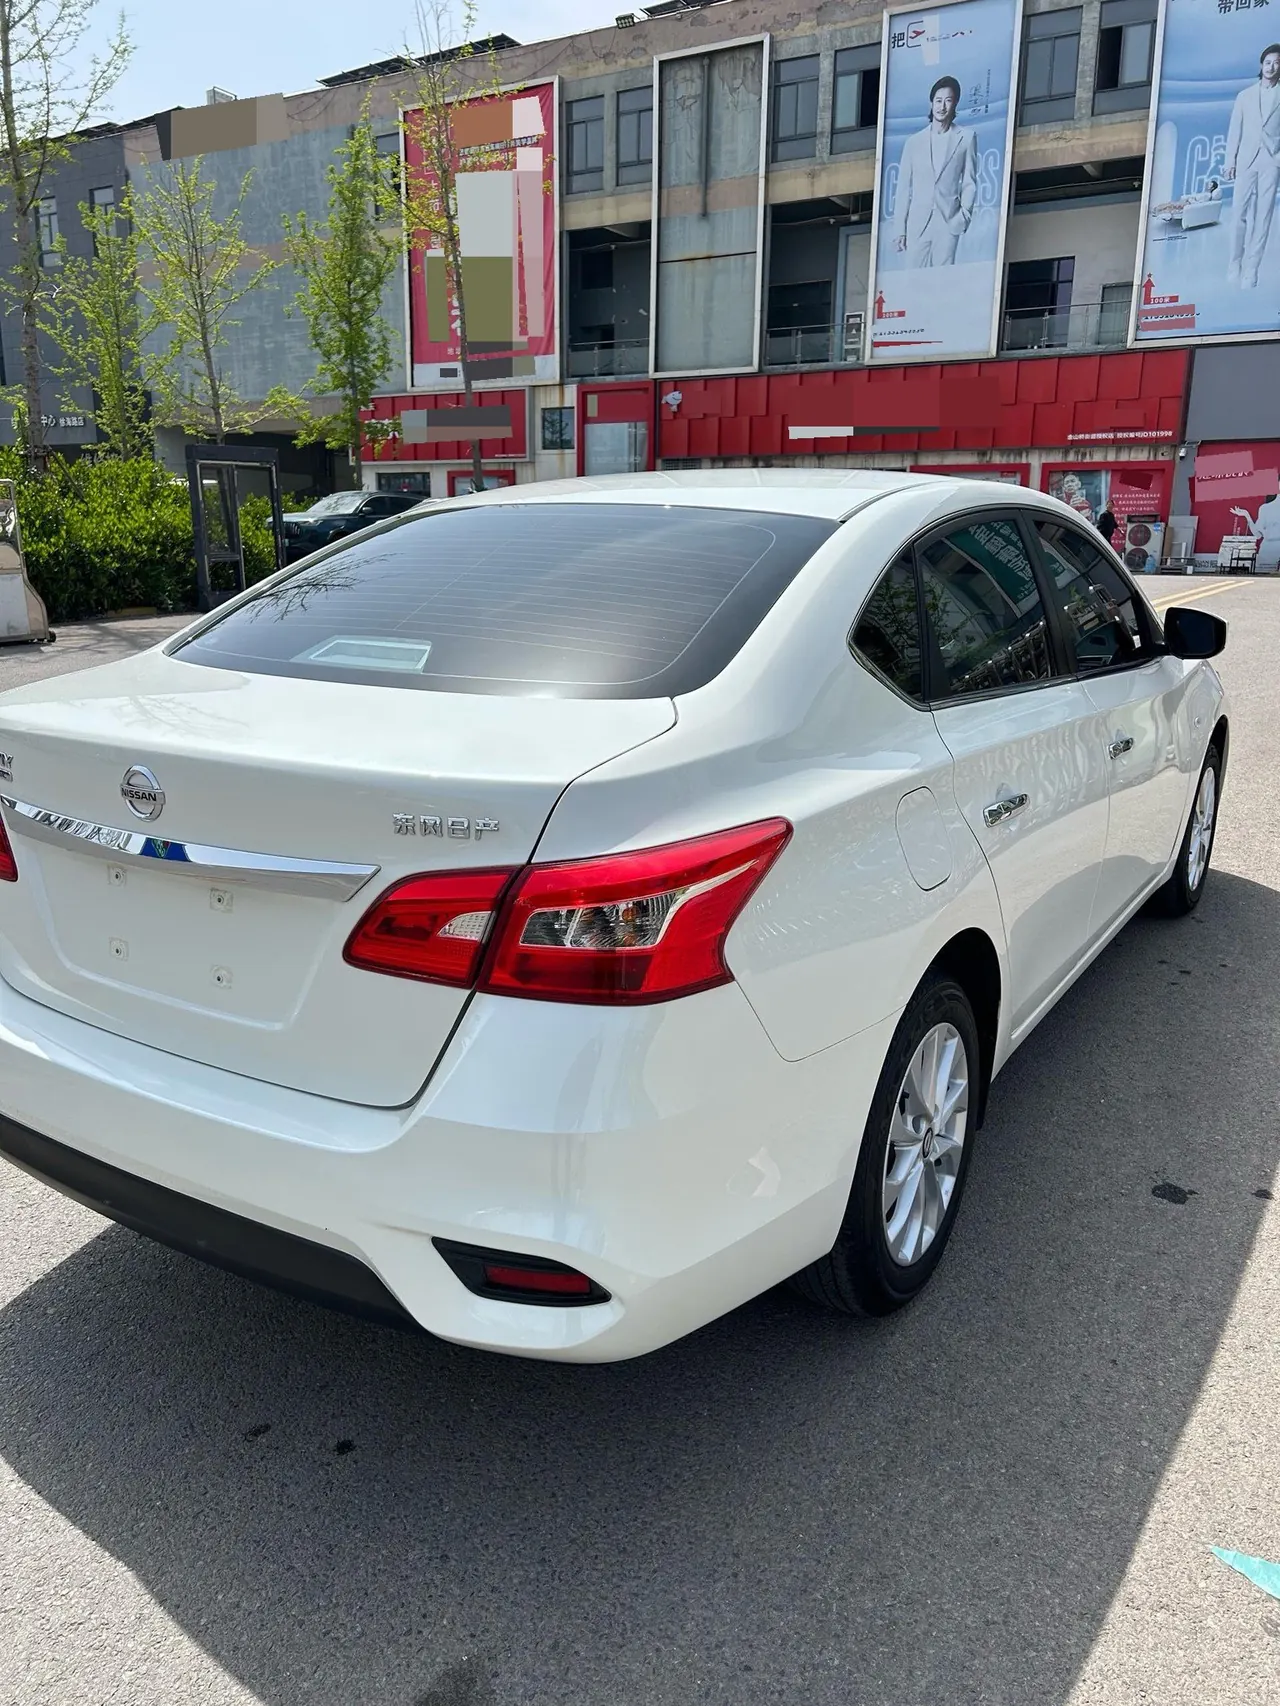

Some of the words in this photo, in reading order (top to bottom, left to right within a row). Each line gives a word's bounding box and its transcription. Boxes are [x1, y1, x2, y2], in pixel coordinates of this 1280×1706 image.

[892, 32, 905, 48] 把
[121, 787, 157, 801] NISSAN
[393, 813, 499, 841] 东风日产
